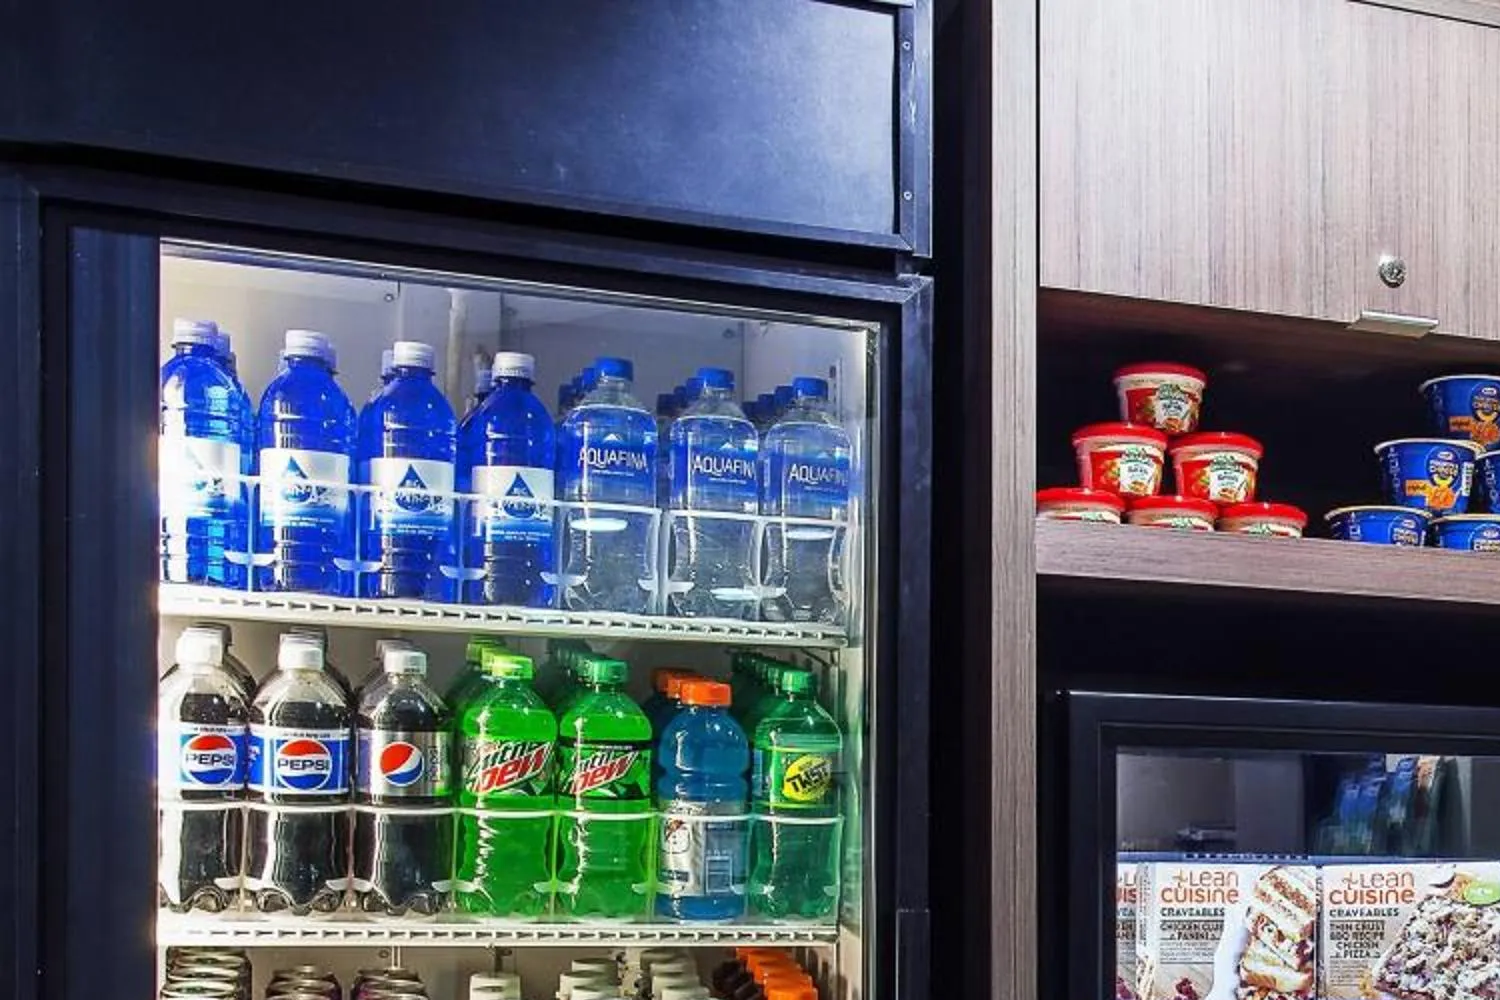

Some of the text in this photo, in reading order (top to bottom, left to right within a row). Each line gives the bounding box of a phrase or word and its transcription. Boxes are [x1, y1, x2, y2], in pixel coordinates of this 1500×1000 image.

[578, 447, 648, 471] AQUAFINA
[692, 455, 756, 480] AQUAFIN
[788, 463, 848, 485] AQUAFI
[277, 759, 330, 771] PEPSI
[1189, 871, 1239, 887] Lean
[1360, 872, 1415, 888] Lean
[1160, 907, 1225, 917] CRAVEABLES
[1329, 909, 1400, 917] CRAVEABLES
